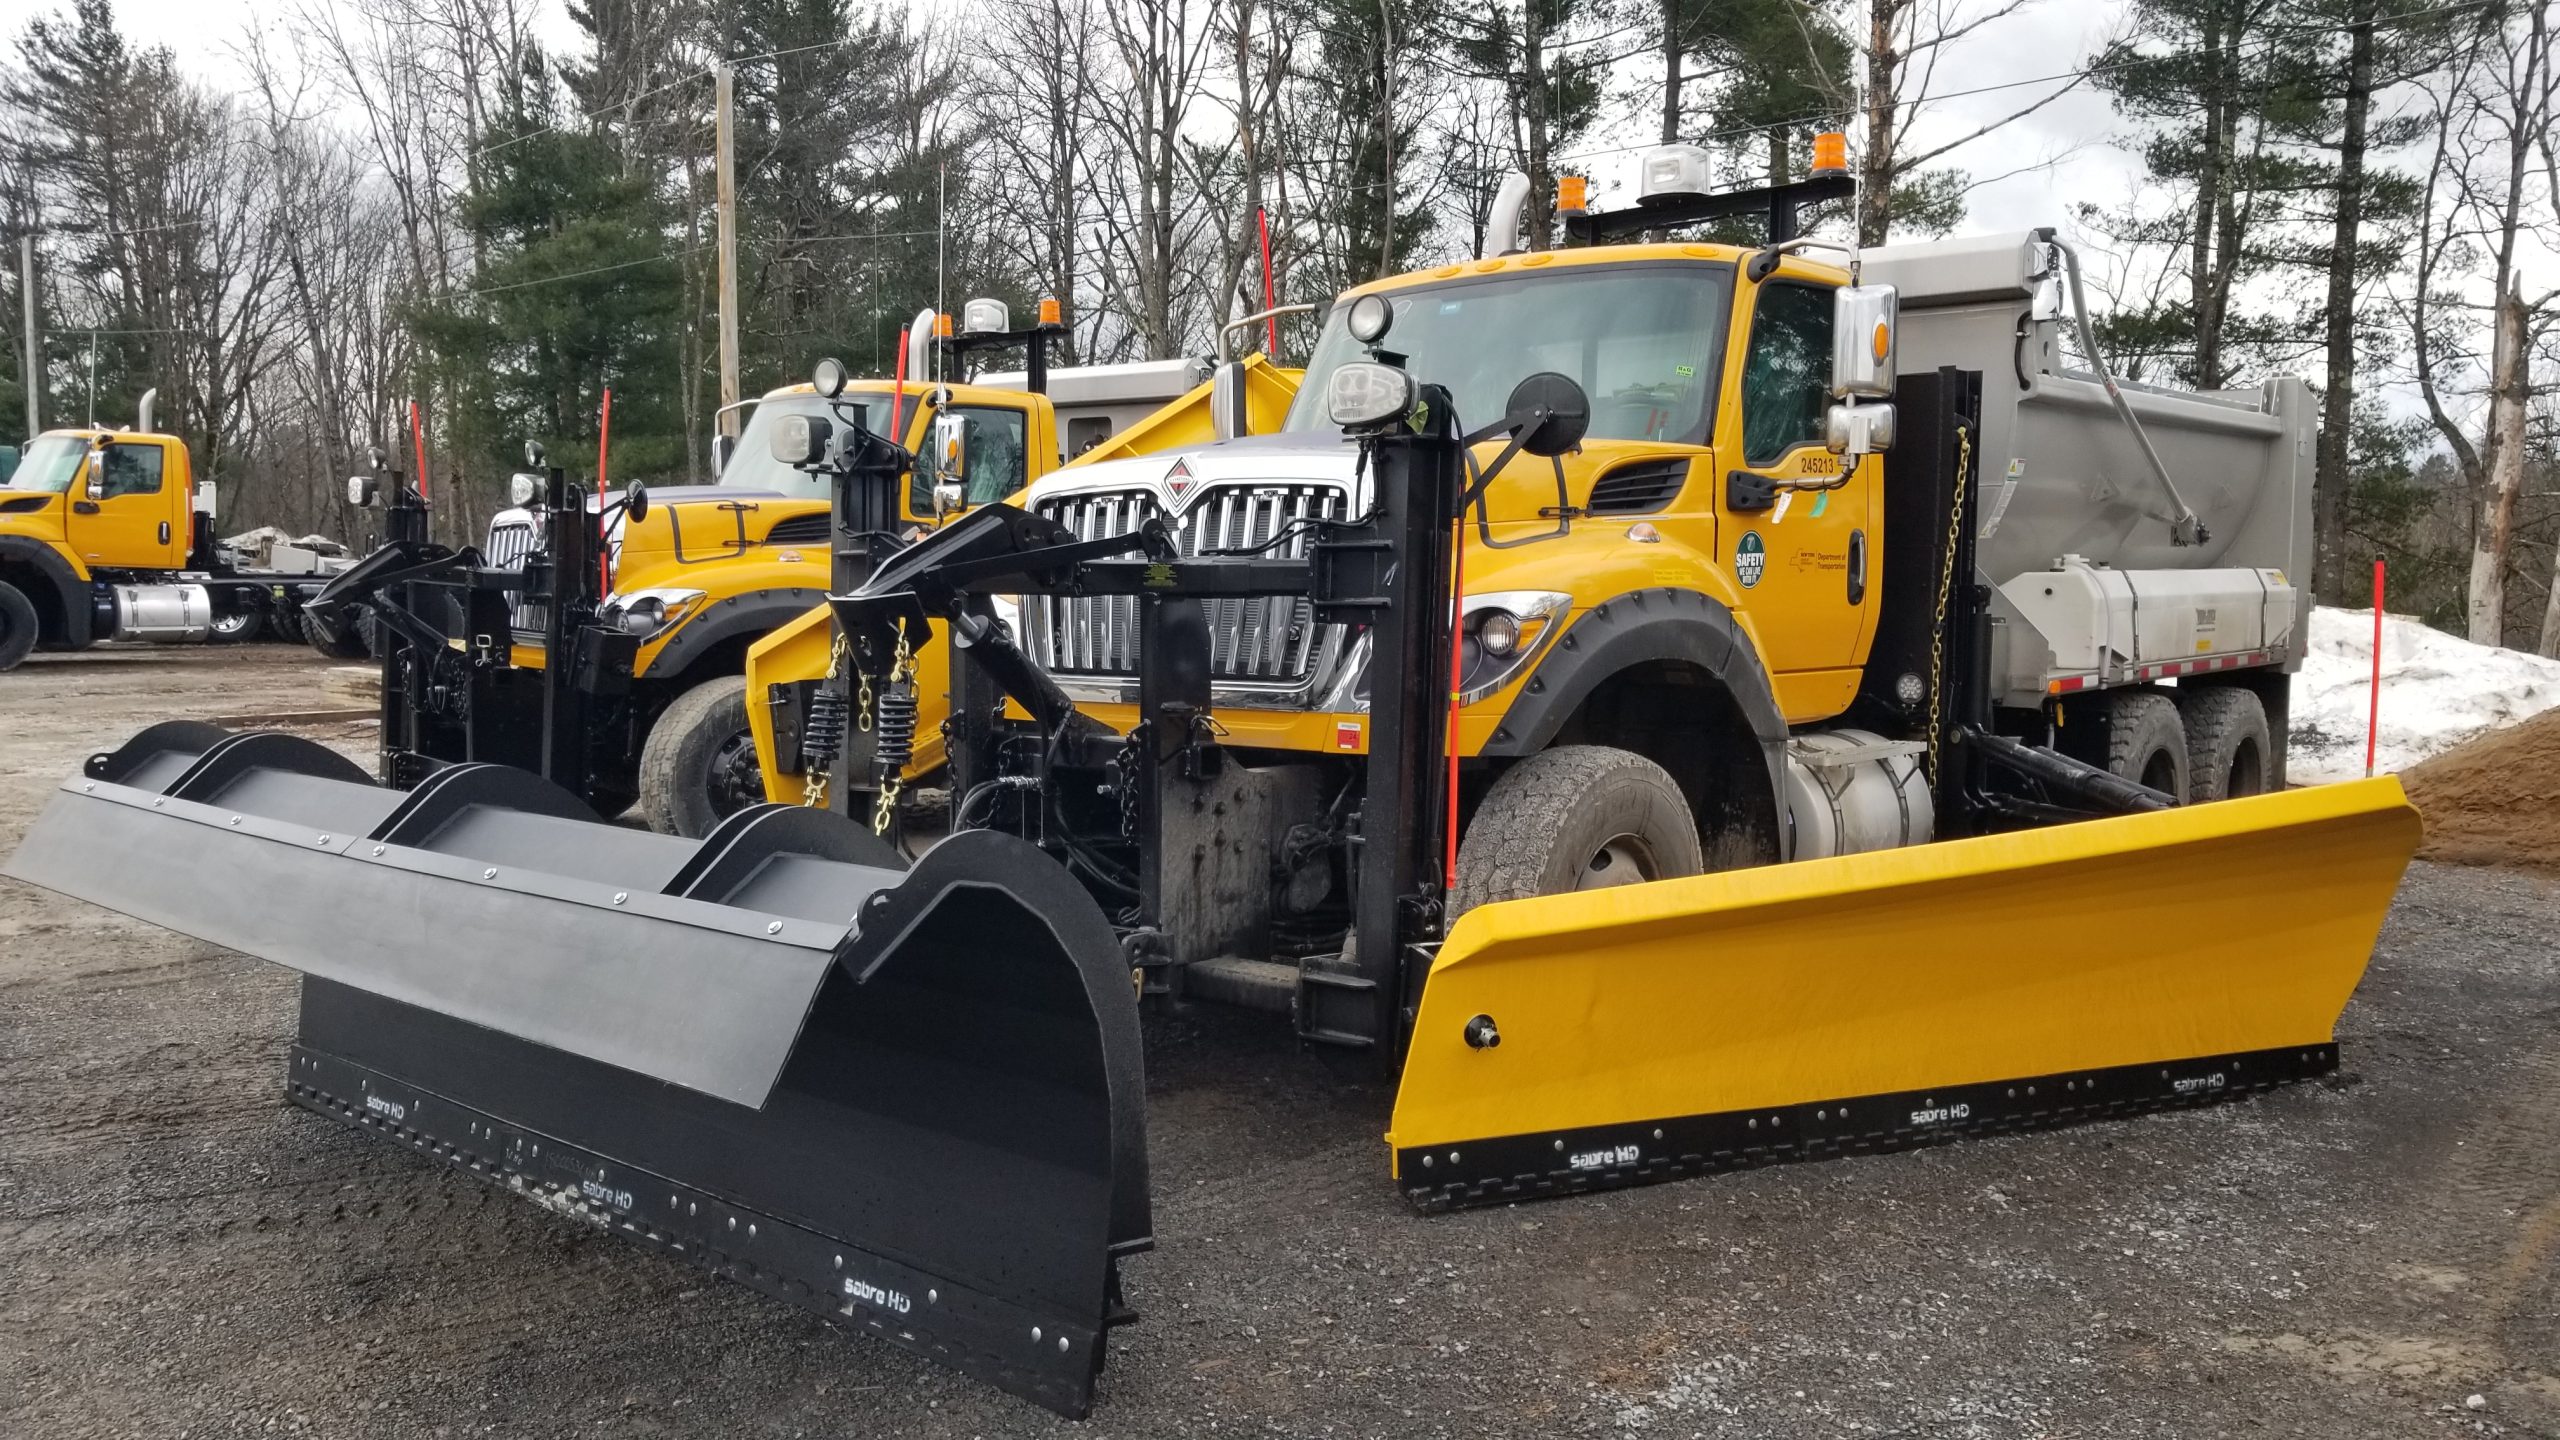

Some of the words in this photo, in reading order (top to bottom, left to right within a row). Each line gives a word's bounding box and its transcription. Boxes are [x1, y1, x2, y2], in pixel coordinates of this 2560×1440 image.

[1801, 457, 1834, 474] 245213
[1736, 552, 1764, 567] SAFETY
[1817, 552, 1840, 561] Department
[1817, 562, 1846, 571] Transportation
[2174, 1078, 2206, 1092] sabre
[2207, 1073, 2224, 1087] HD
[366, 1096, 390, 1114] sabre
[390, 1102, 405, 1119] HD
[1911, 1109, 1948, 1124] sabre
[1950, 1104, 1970, 1118] HD
[1615, 1145, 1639, 1162] HD
[583, 1181, 613, 1202] sabre
[615, 1190, 633, 1209] HD
[844, 1277, 885, 1305] sabre
[887, 1289, 911, 1313] HD
